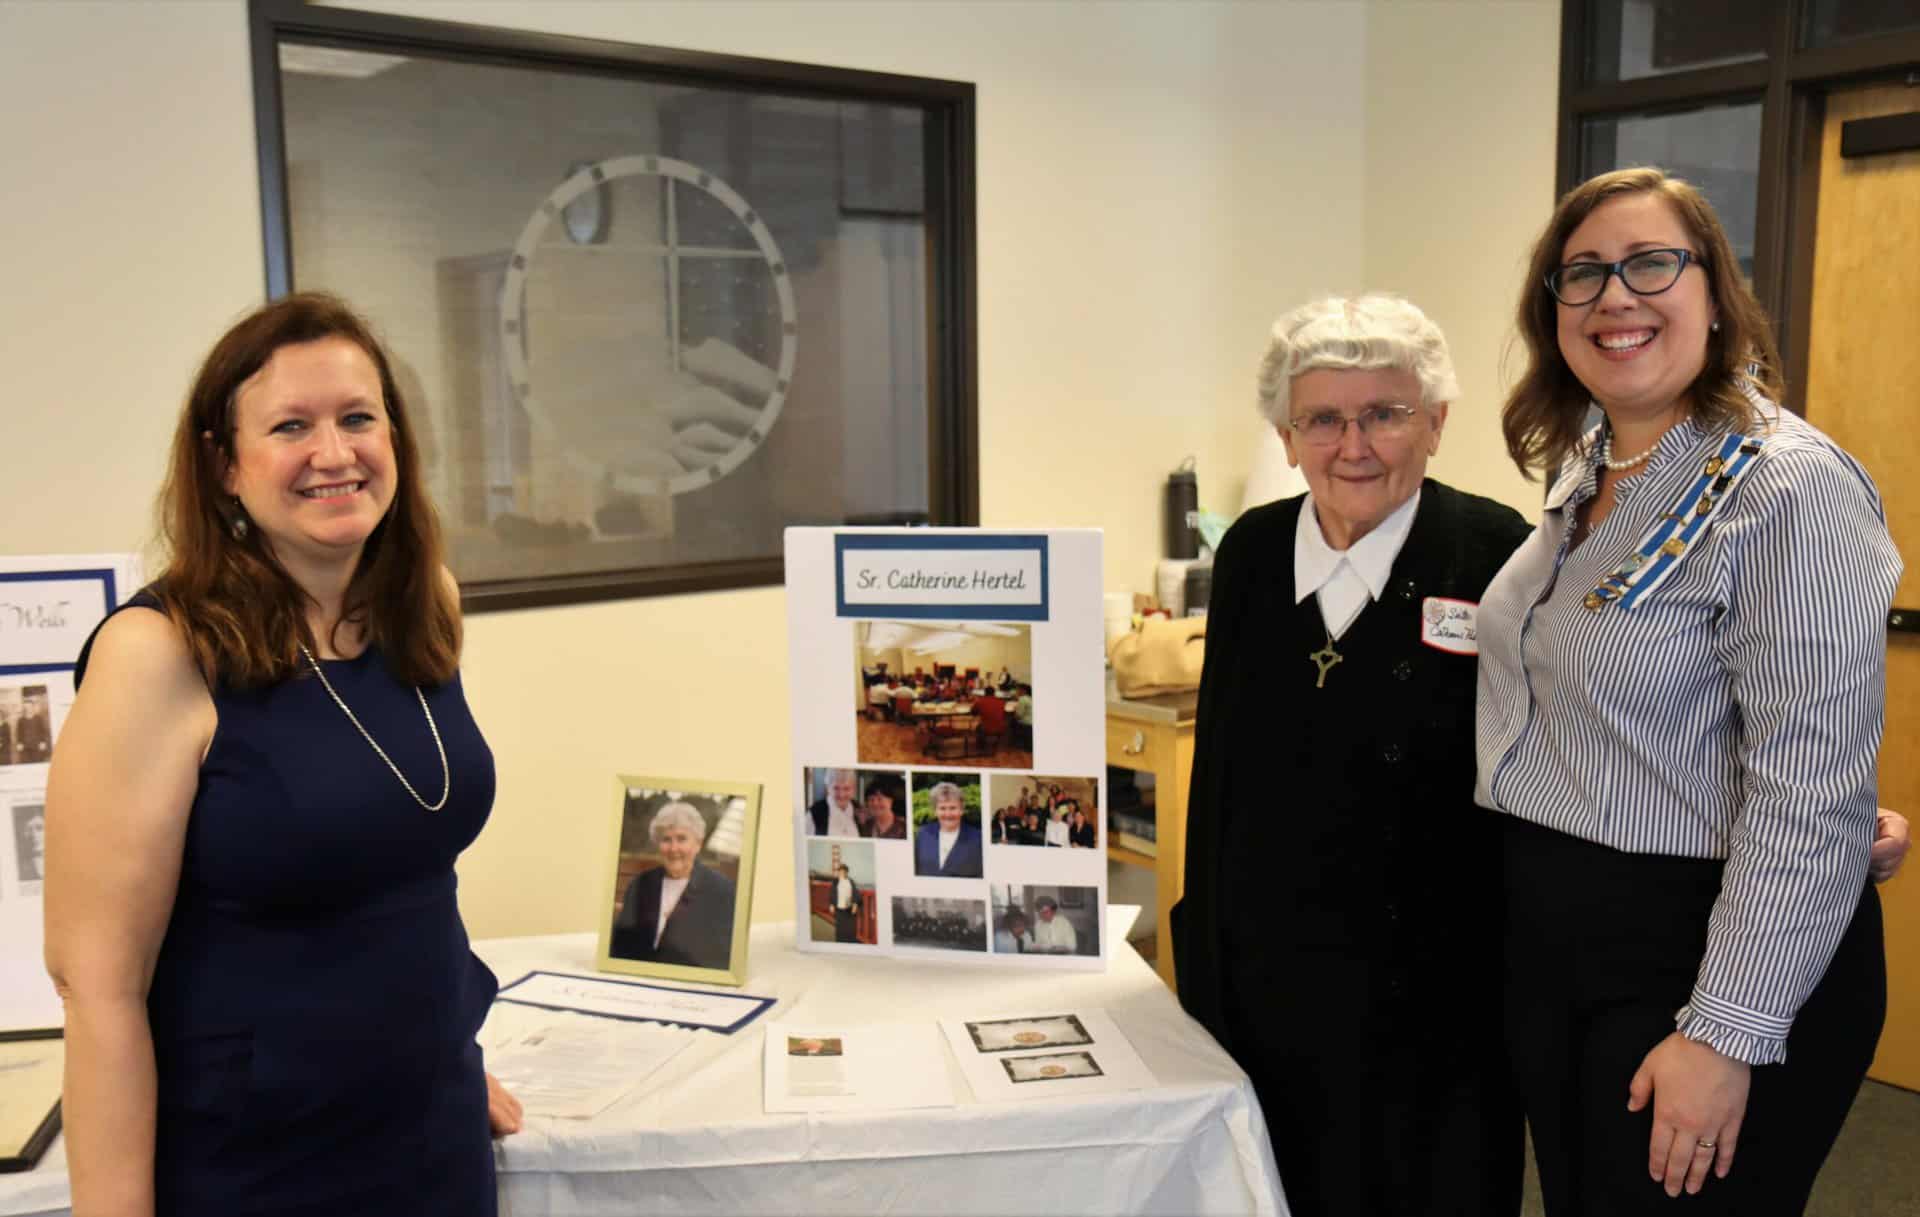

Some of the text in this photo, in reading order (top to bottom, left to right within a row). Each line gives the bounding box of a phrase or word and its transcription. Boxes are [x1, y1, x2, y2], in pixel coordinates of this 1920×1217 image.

[857, 568, 1027, 590] Sr. Catherine Hertel
